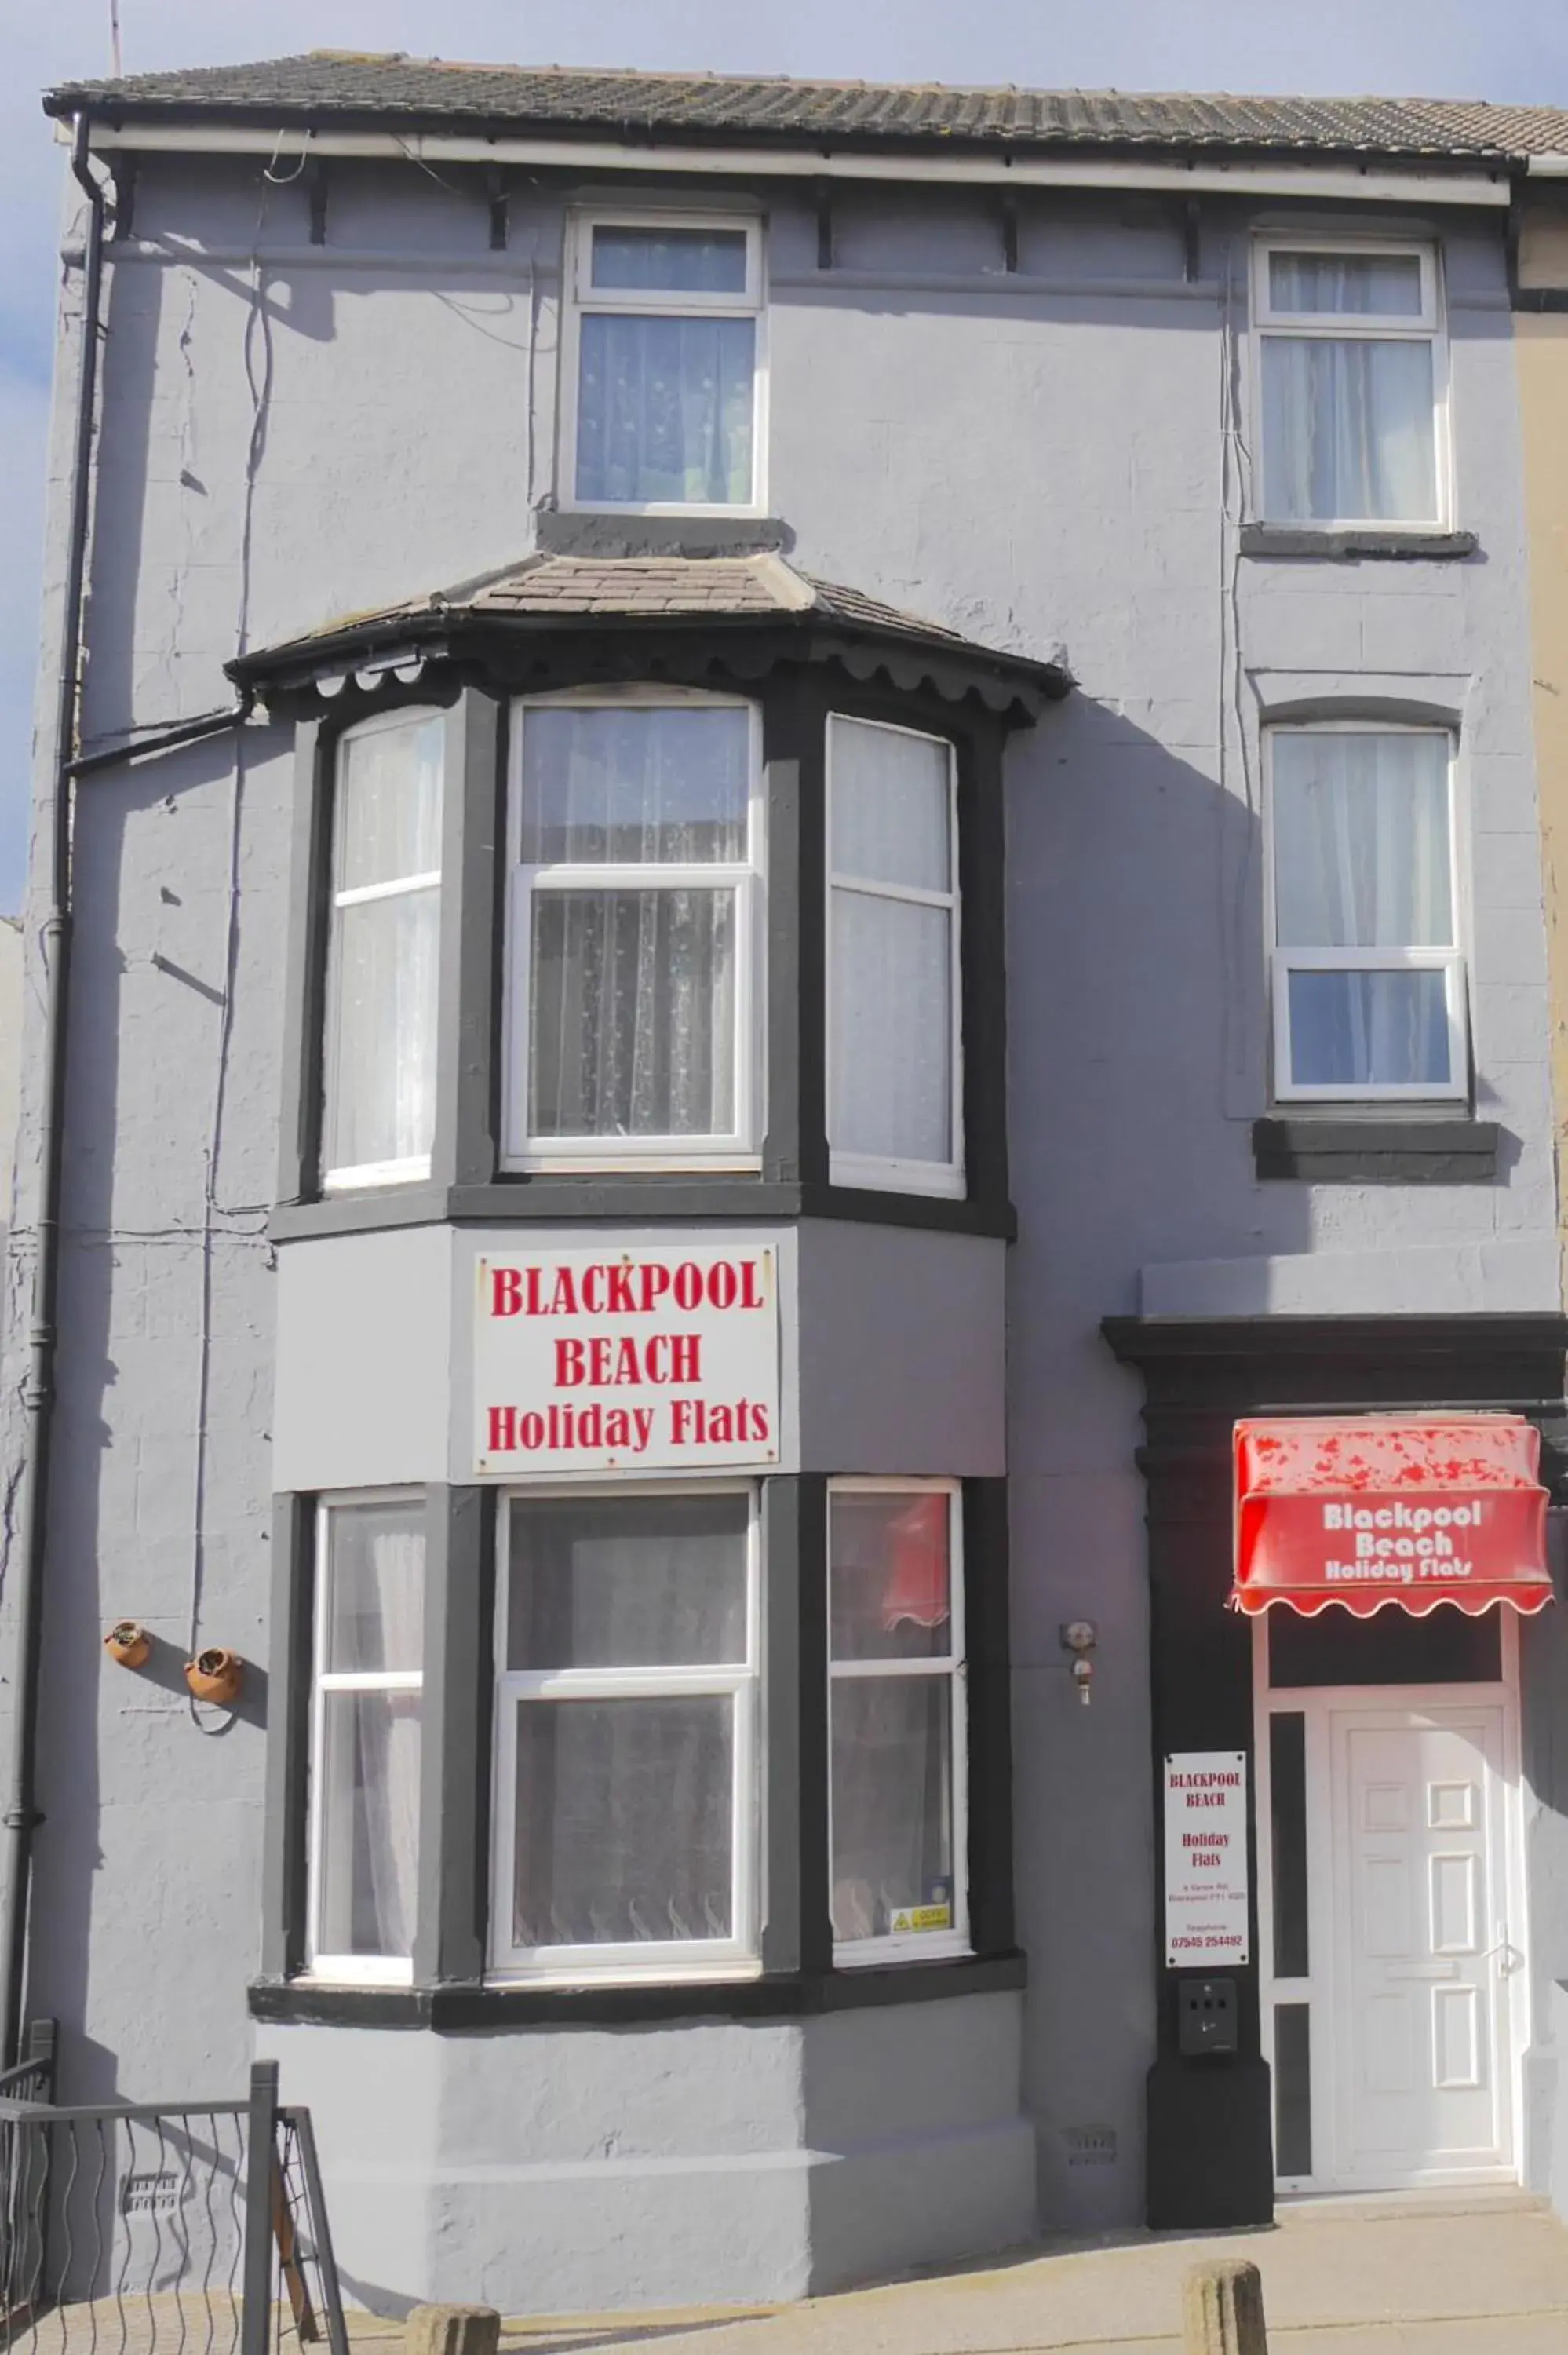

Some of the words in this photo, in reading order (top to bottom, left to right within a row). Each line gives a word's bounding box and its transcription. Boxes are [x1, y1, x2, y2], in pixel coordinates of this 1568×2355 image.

[490, 1261, 764, 1316] BLACKPOOL
[554, 1334, 702, 1387] BEACH
[487, 1402, 655, 1453] Holiday
[669, 1396, 769, 1444] Flats
[1323, 1500, 1482, 1533] Blackpool
[1356, 1531, 1453, 1557] Beach
[1325, 1559, 1413, 1584] Holiday
[1420, 1557, 1473, 1577] Flats
[1170, 1773, 1241, 1787] BLACKPOOL
[1186, 1792, 1225, 1808] BEACH
[1183, 1833, 1230, 1847] Holiday
[1192, 1853, 1221, 1868] Flats
